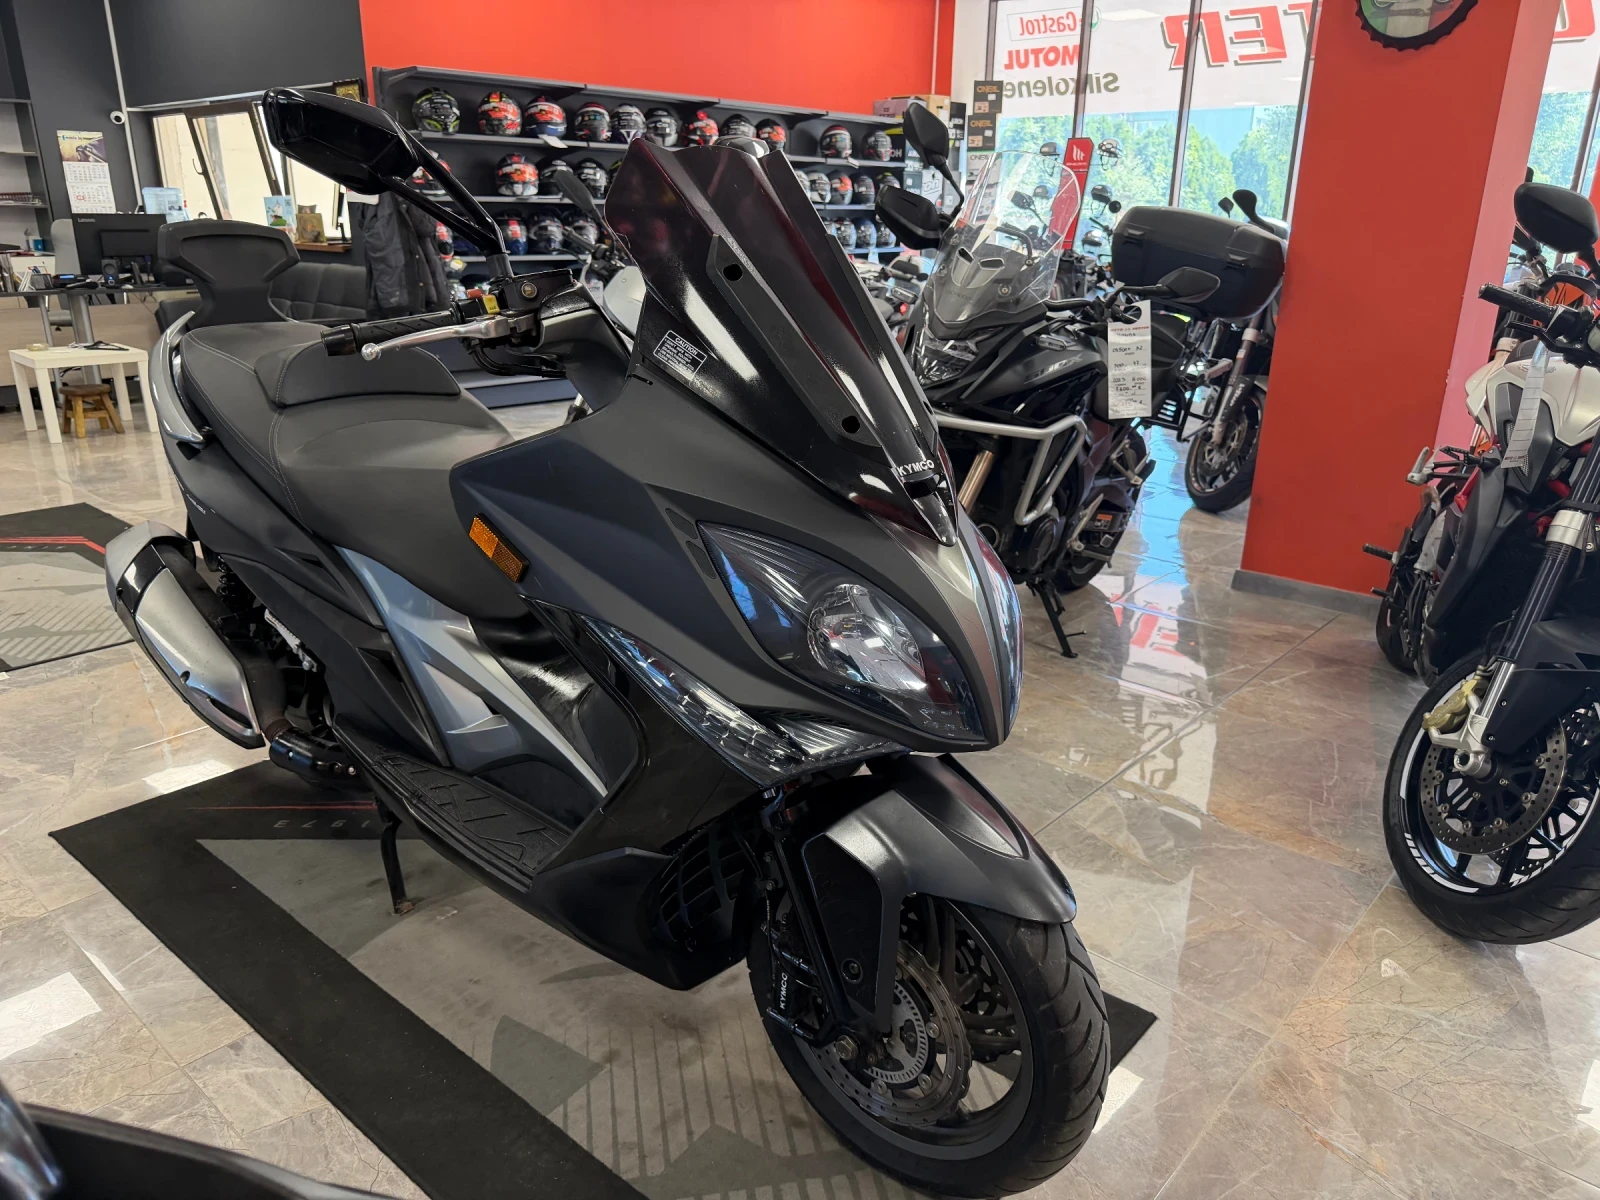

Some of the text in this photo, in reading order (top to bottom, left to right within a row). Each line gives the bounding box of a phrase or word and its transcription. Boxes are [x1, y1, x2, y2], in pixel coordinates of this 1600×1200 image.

[675, 337, 698, 355] CAUTION
[896, 459, 935, 477] KYMCO
[779, 972, 788, 1010] KYMCO
